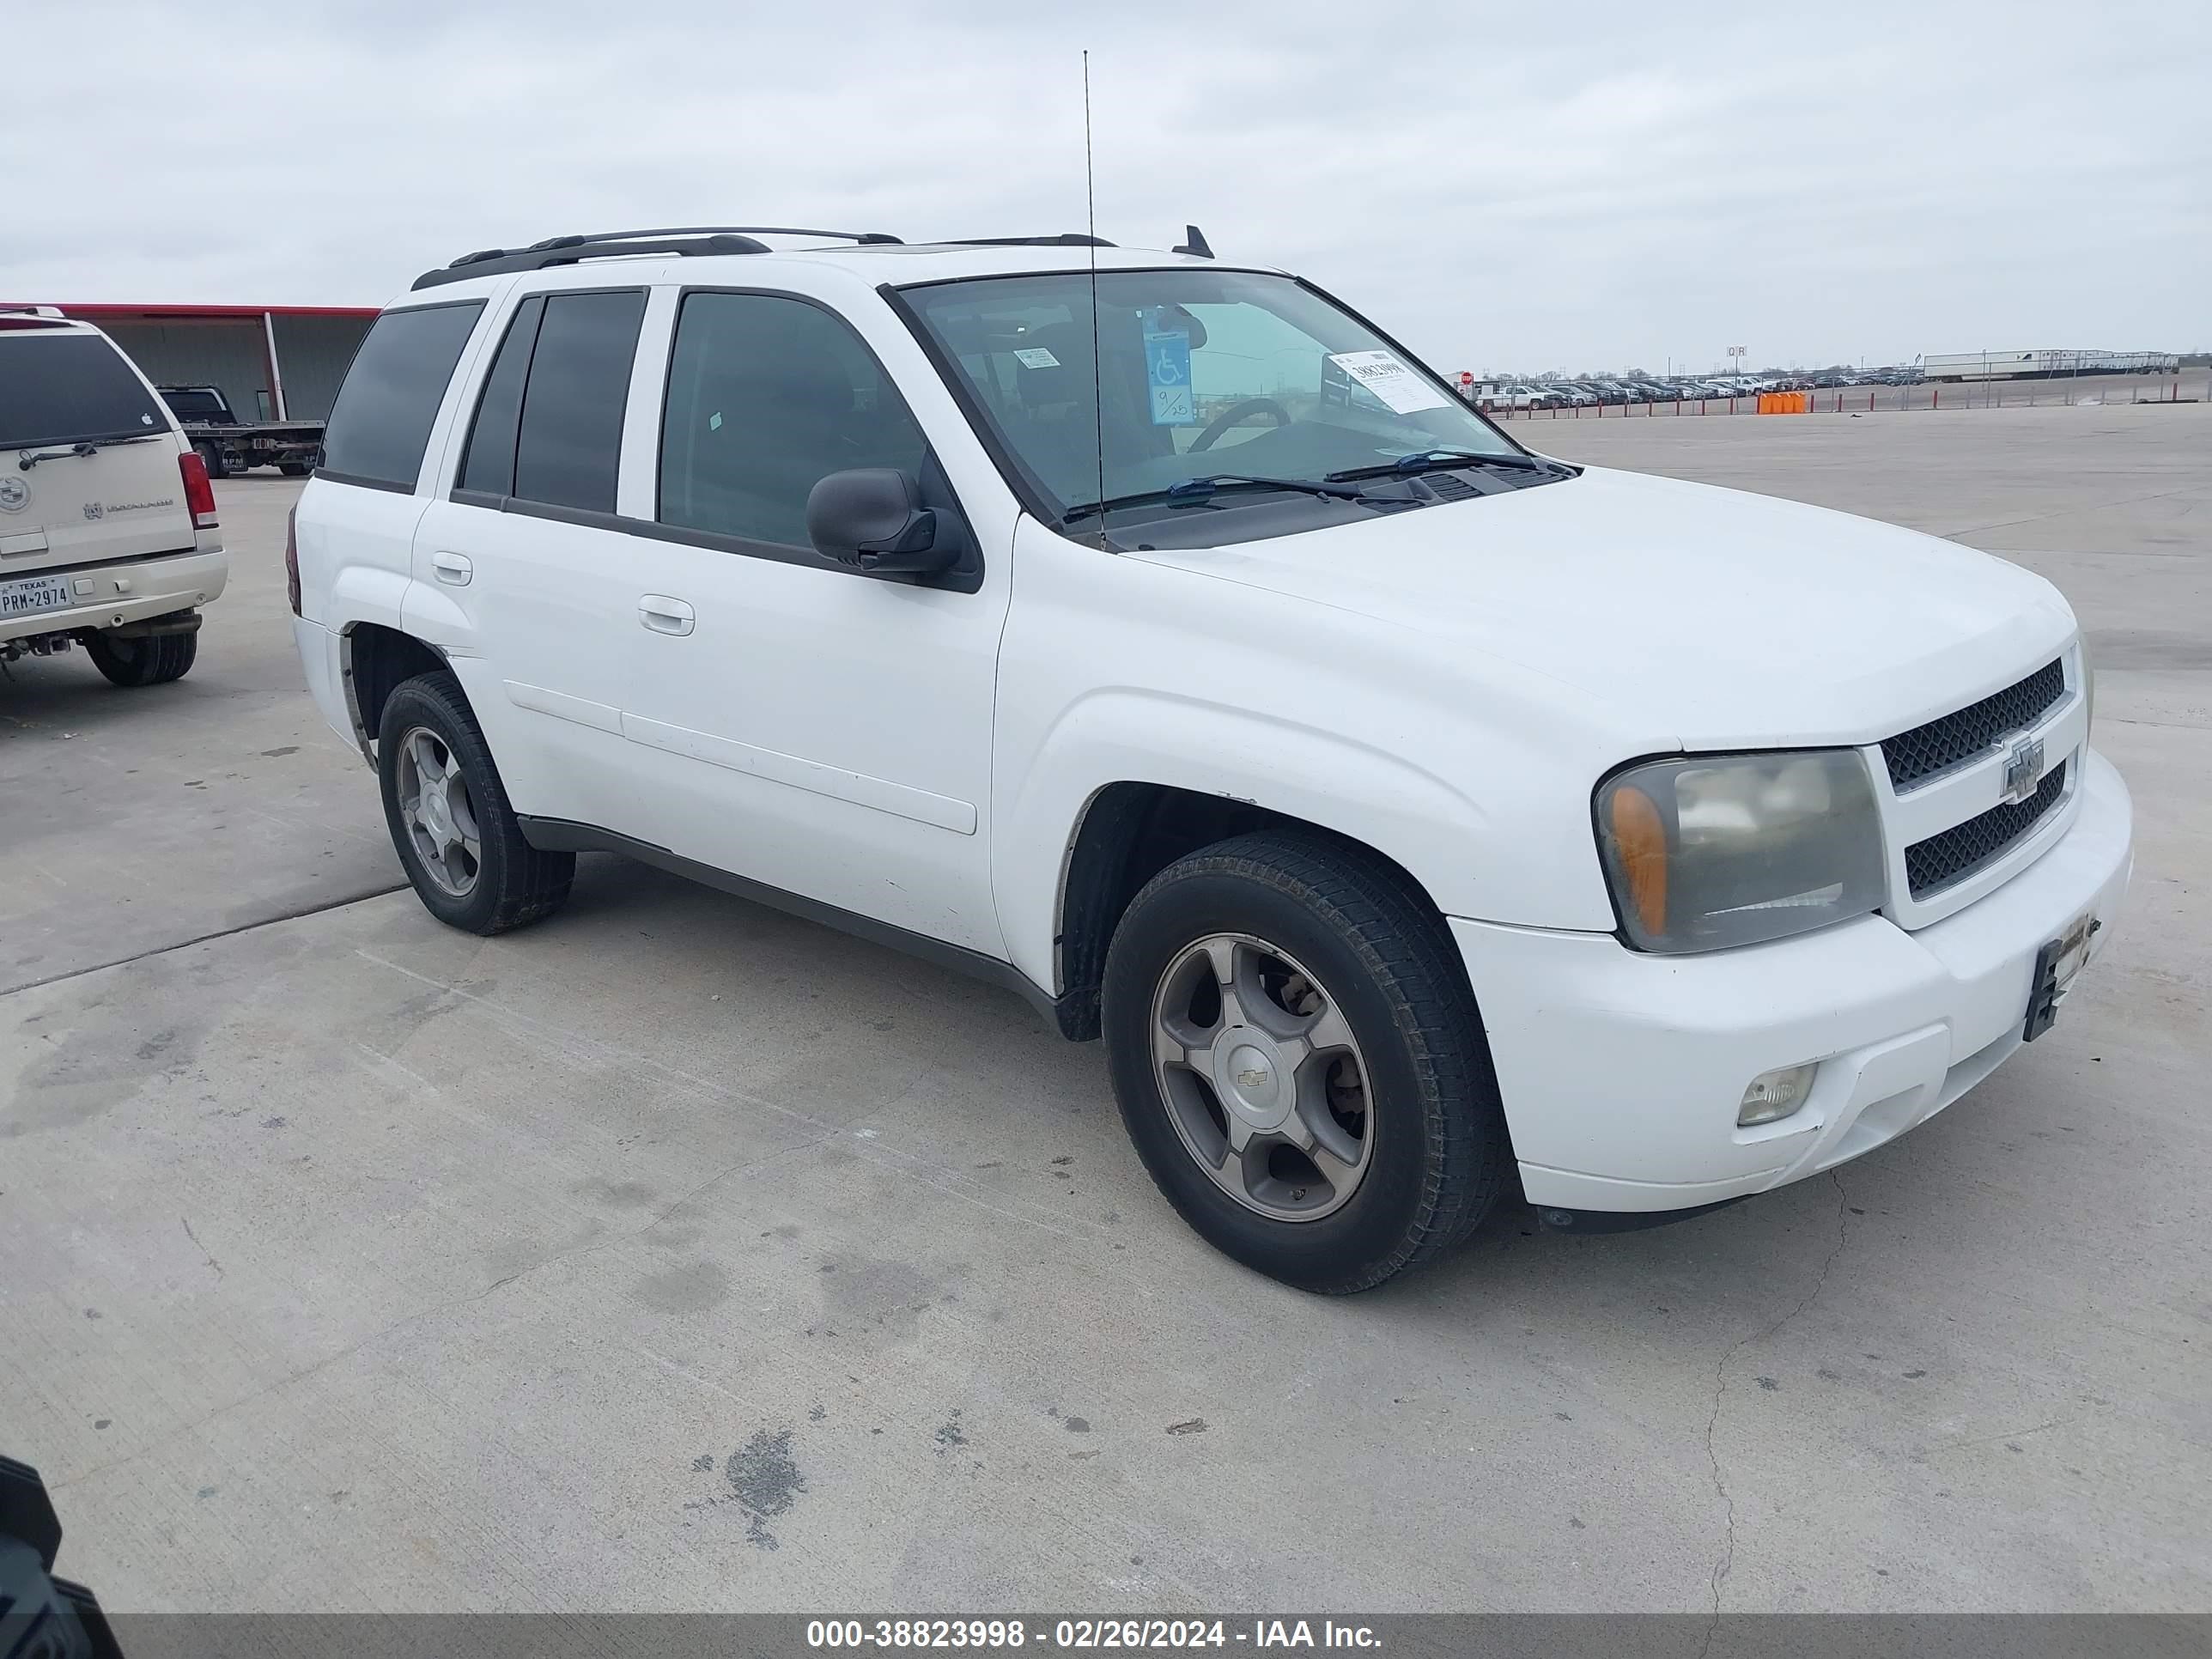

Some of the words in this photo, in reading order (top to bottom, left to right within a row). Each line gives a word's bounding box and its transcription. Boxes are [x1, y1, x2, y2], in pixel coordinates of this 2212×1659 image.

[1739, 347, 1745, 356] R
[1352, 362, 1406, 379] 38823998
[19, 580, 47, 591] TEXAS
